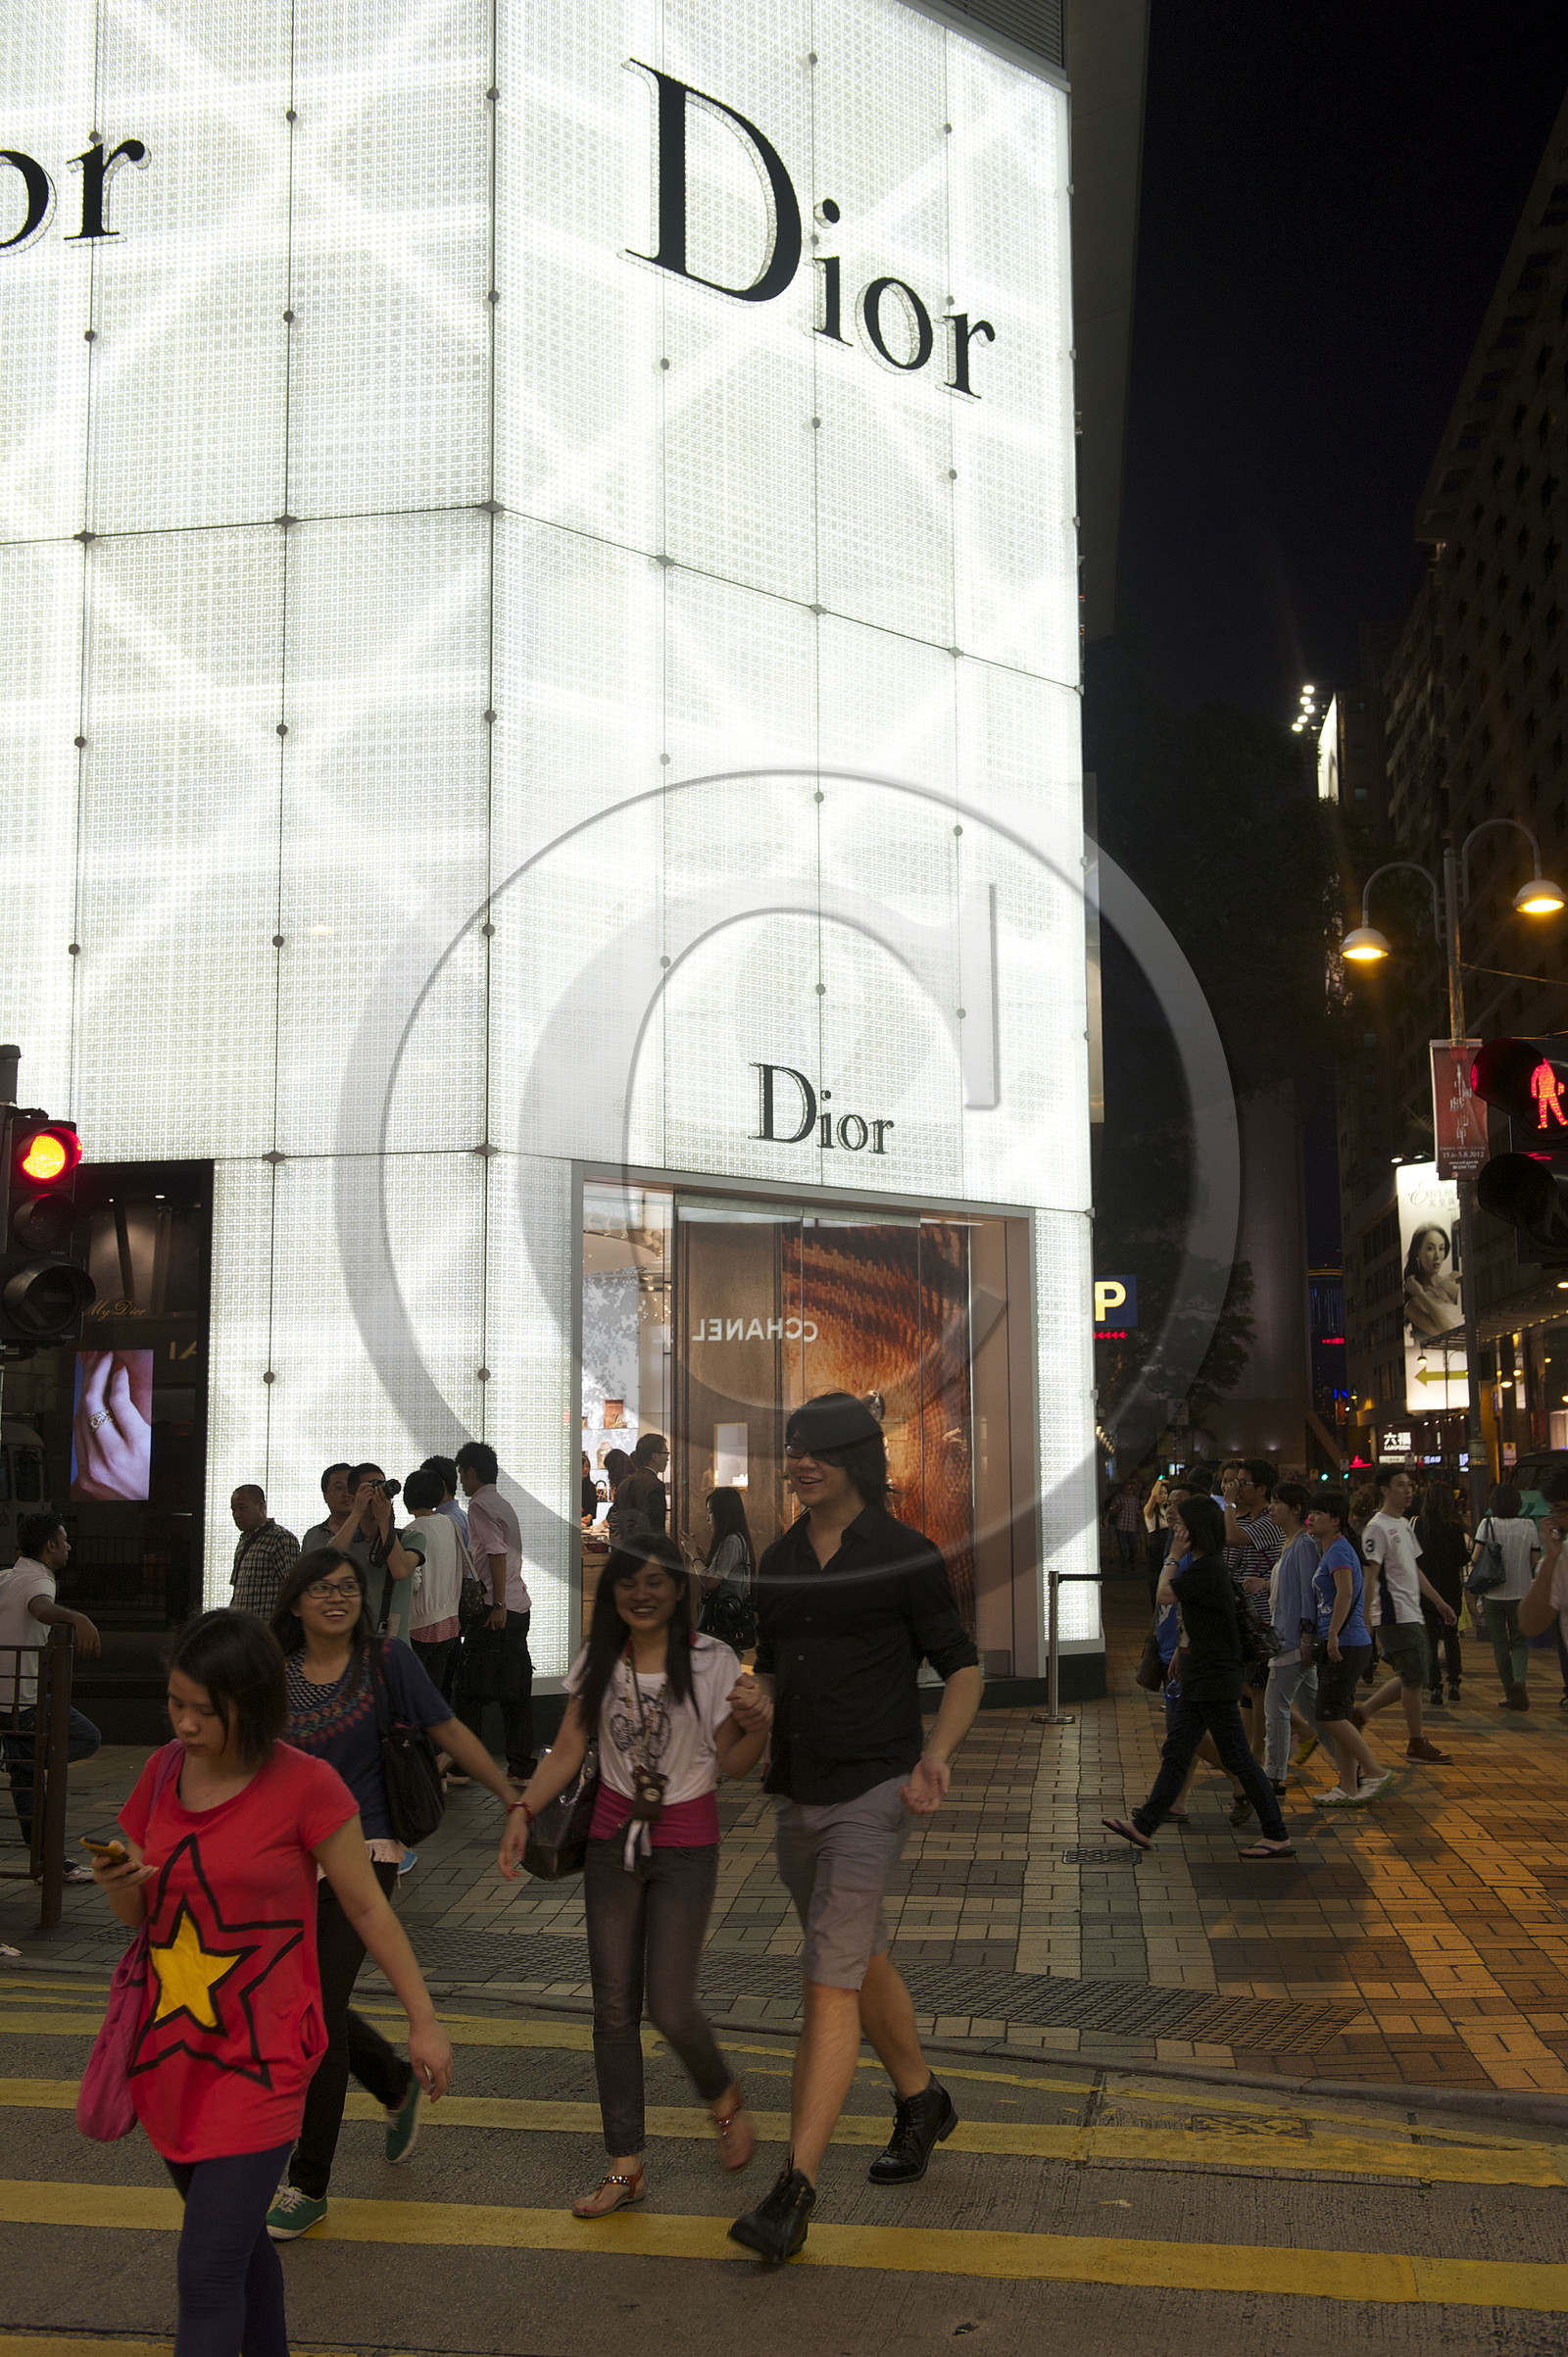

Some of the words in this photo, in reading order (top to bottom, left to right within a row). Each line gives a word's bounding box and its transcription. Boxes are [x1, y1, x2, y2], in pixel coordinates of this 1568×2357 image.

[616, 58, 996, 403] Dior
[748, 1062, 895, 1154] Dior
[112, 1300, 146, 1316] Dior
[1094, 1281, 1126, 1321] P
[1383, 1431, 1411, 1446] 六福
[1365, 1539, 1374, 1552] 3
